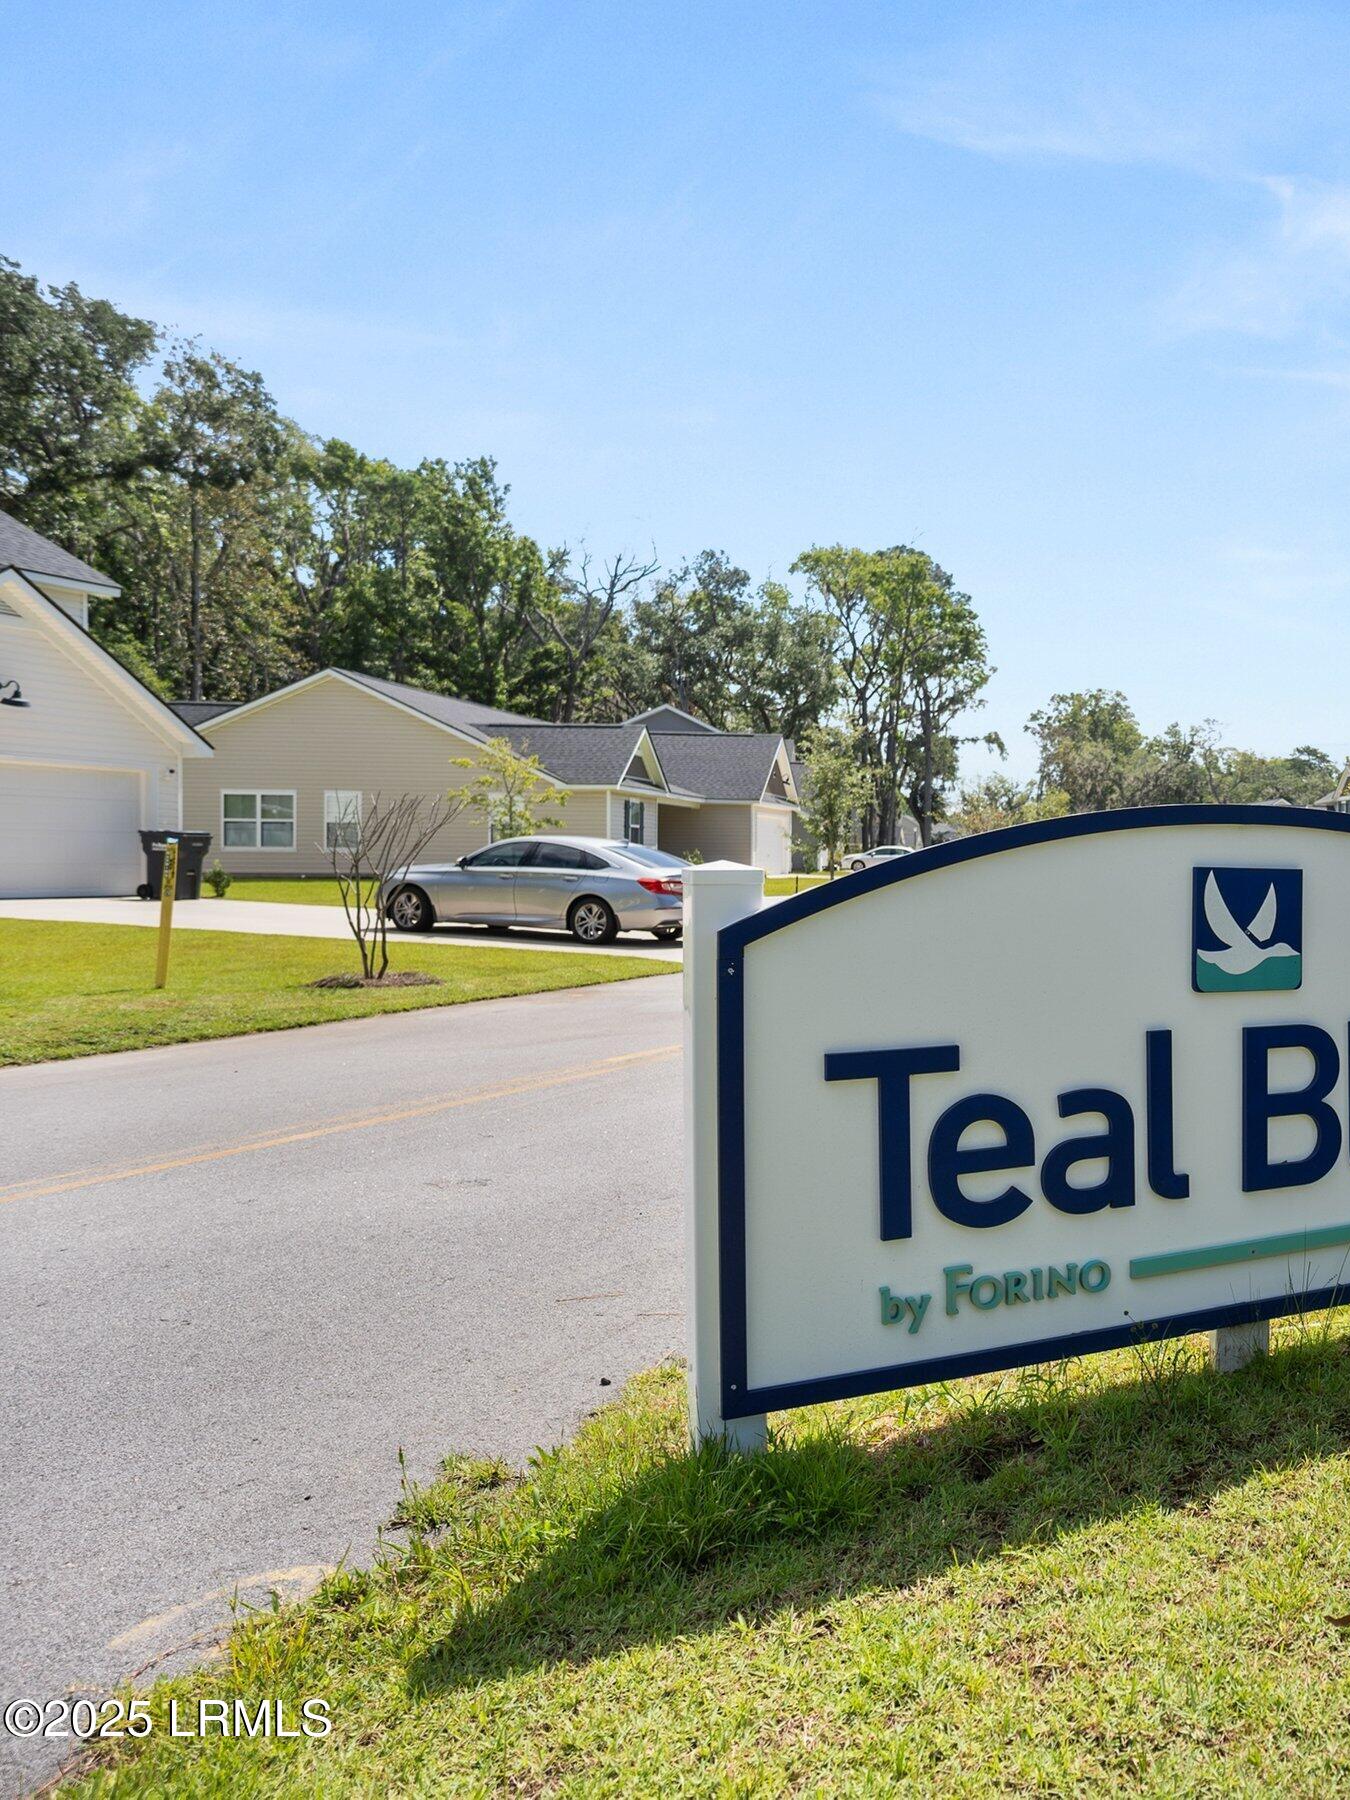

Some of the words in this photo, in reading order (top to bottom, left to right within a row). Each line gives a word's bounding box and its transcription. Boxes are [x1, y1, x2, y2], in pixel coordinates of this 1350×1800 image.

[824, 1029, 1189, 1241] Teal
[879, 1286, 932, 1334] by
[943, 1259, 1111, 1316] FORINO
